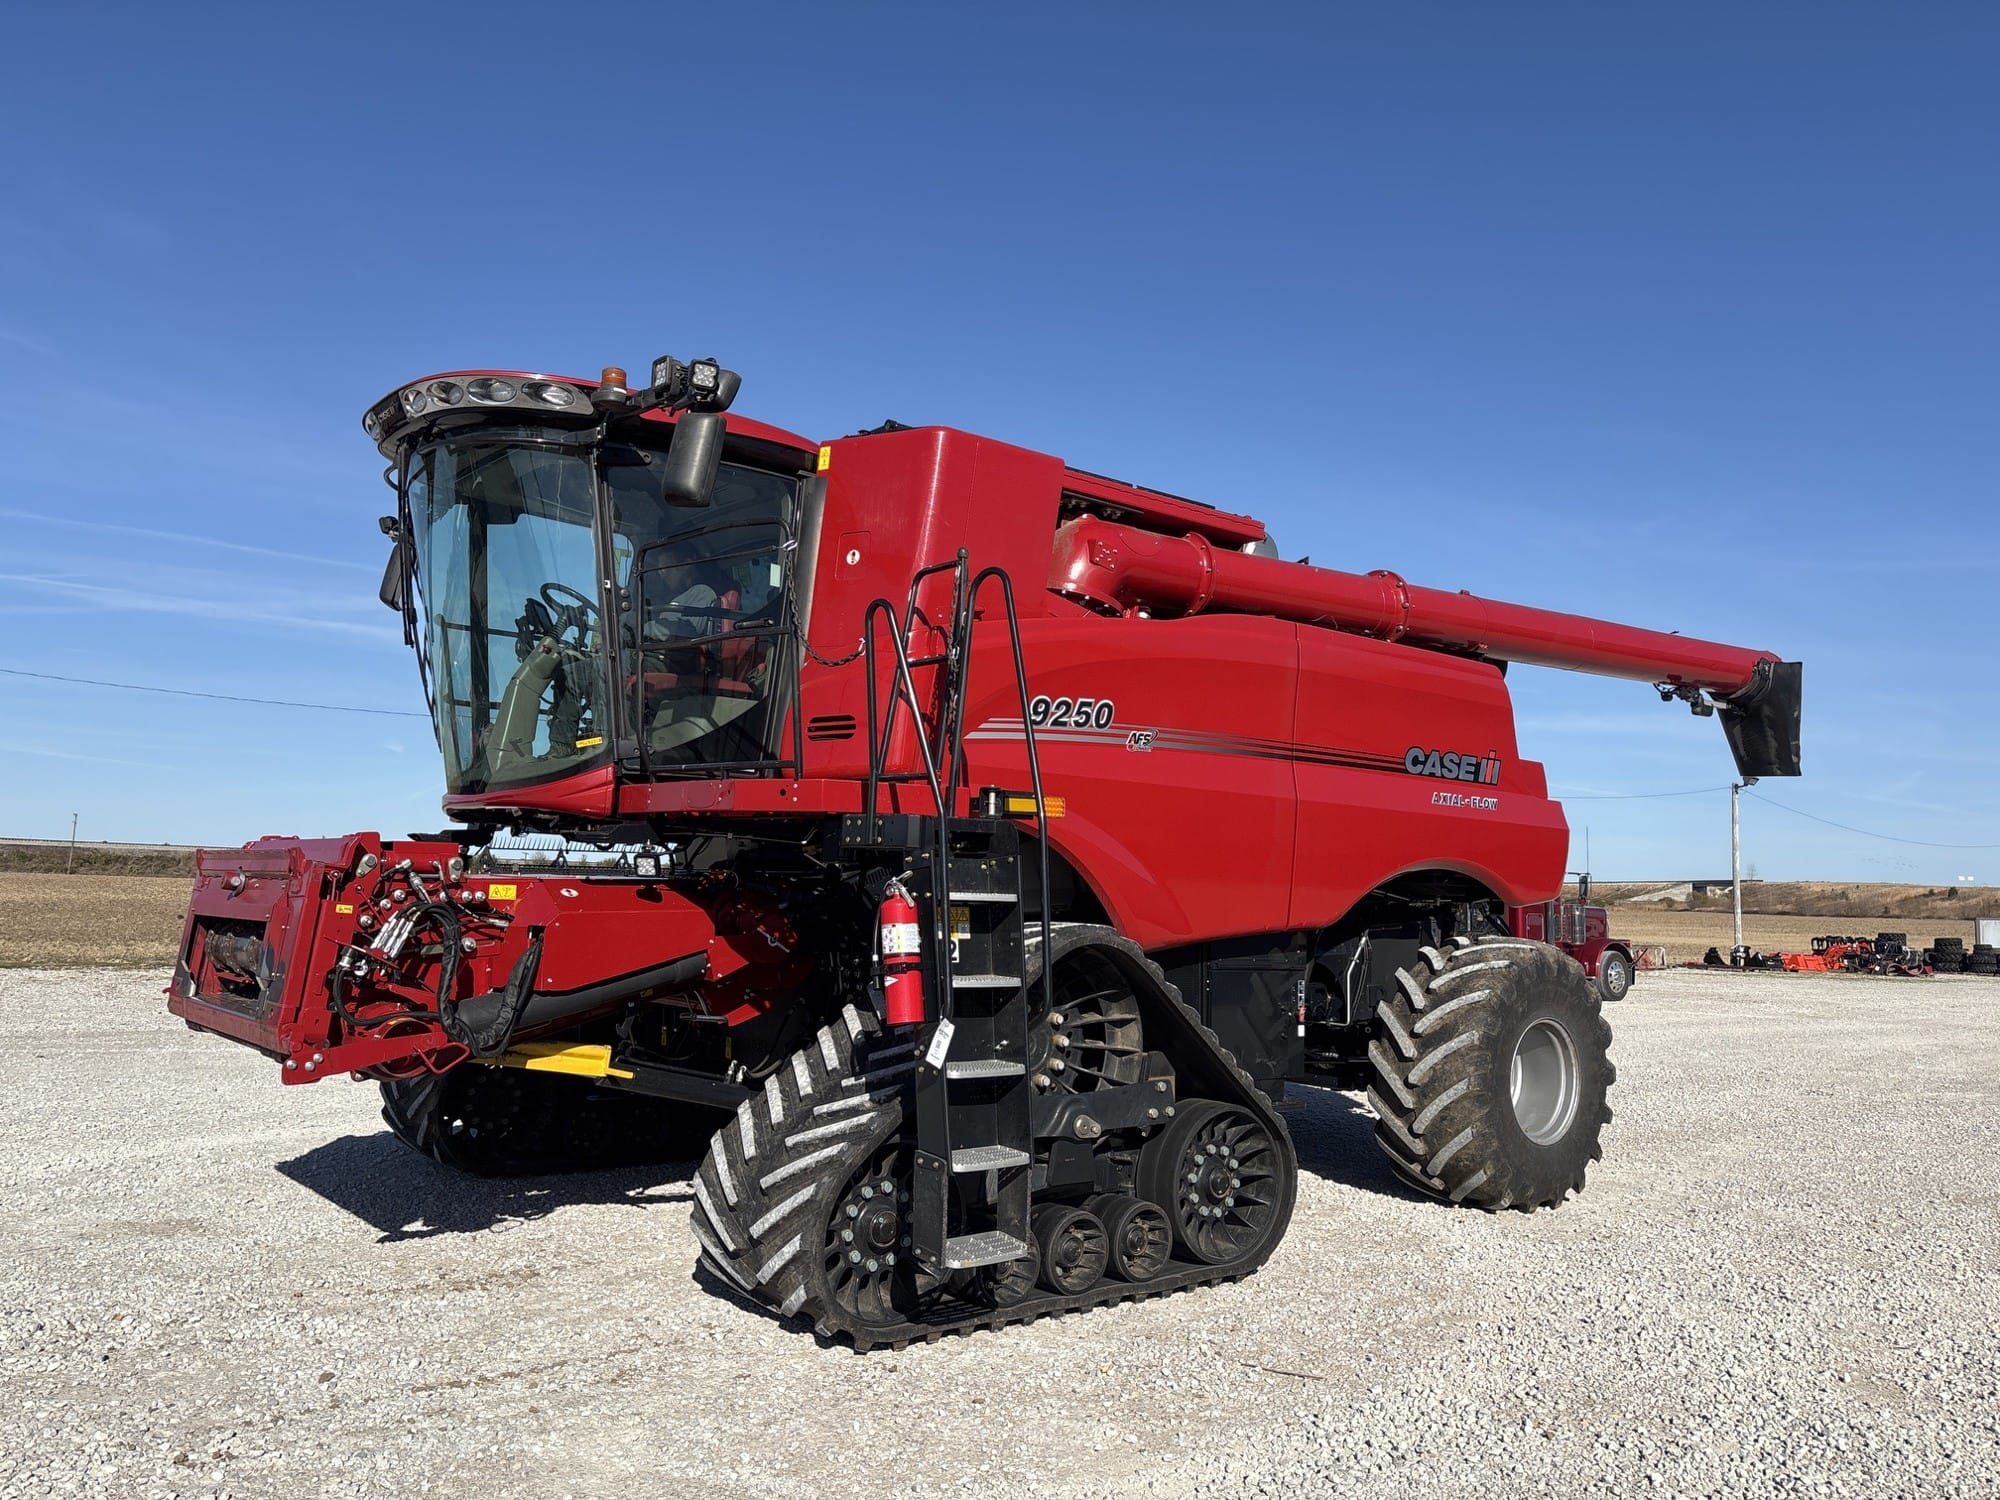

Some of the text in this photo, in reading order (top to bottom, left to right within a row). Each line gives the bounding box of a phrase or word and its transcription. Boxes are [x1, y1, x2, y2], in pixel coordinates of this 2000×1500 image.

[1030, 696, 1114, 729] 9250
[1126, 731, 1153, 745] AFS
[1405, 746, 1477, 781] CASE
